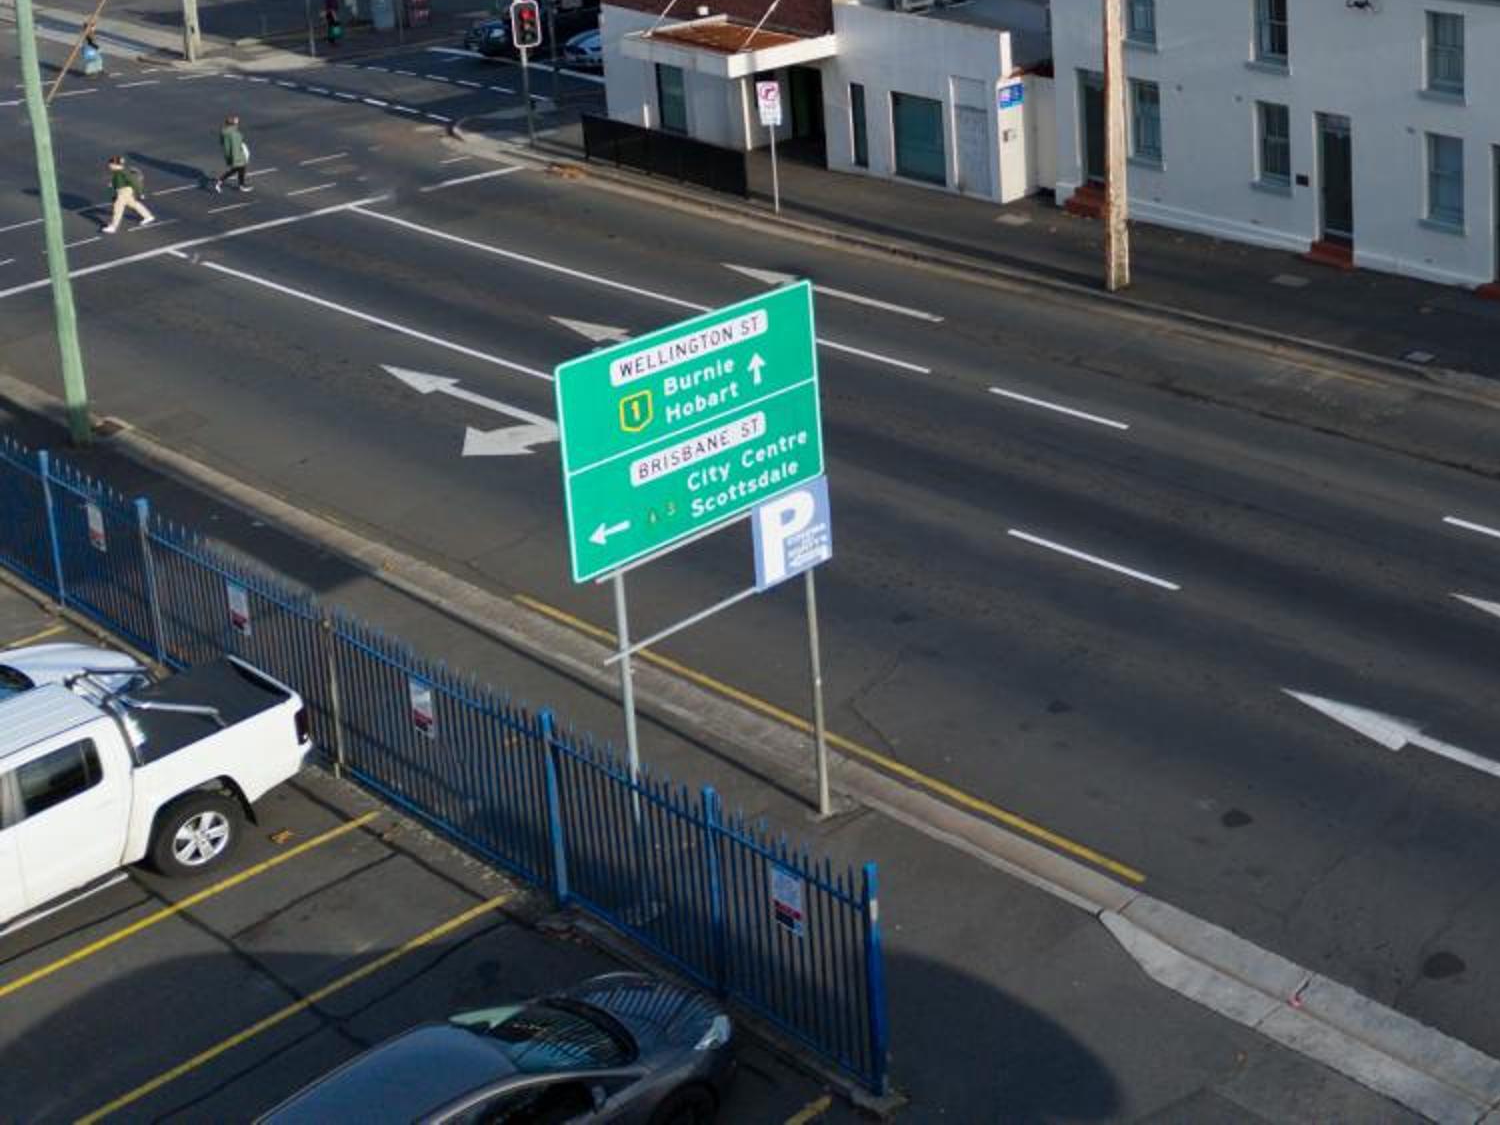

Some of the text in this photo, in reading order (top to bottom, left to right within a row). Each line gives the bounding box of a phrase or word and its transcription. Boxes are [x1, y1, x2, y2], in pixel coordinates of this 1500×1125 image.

[619, 315, 760, 377] WELLINGTON ST
[663, 359, 735, 396] Burnie
[665, 381, 739, 424] Hobart
[631, 399, 641, 422] 1
[638, 417, 760, 479] BRISBANE ST
[687, 430, 808, 491] City Centre
[690, 461, 799, 518] Scottsdale
[760, 490, 815, 586] P
